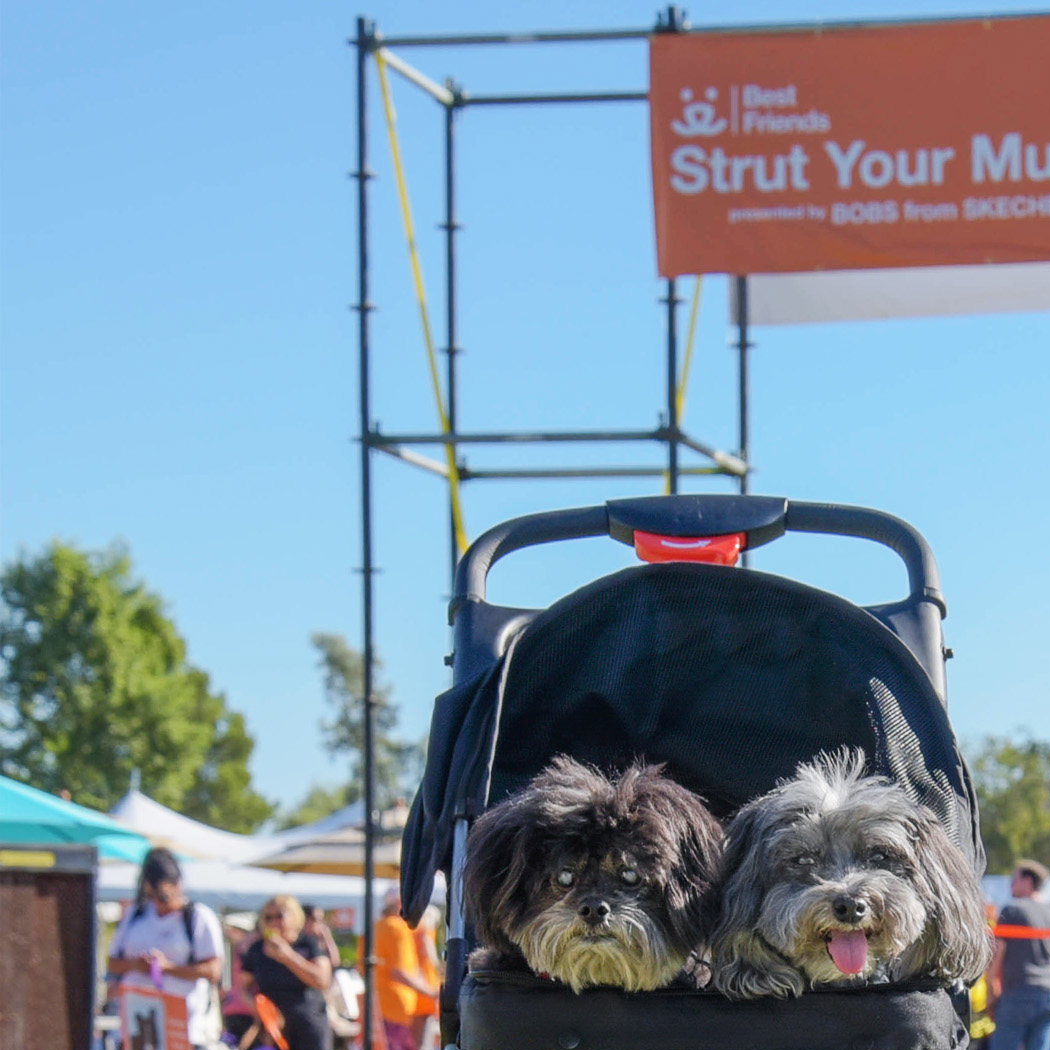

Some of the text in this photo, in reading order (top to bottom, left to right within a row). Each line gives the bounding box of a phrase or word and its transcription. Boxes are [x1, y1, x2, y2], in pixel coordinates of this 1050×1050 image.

[743, 85, 797, 108] Best
[743, 110, 830, 133] Friends
[670, 144, 810, 194] Strut
[824, 139, 955, 189] Your
[831, 201, 899, 225] BOBS
[904, 201, 958, 221] from
